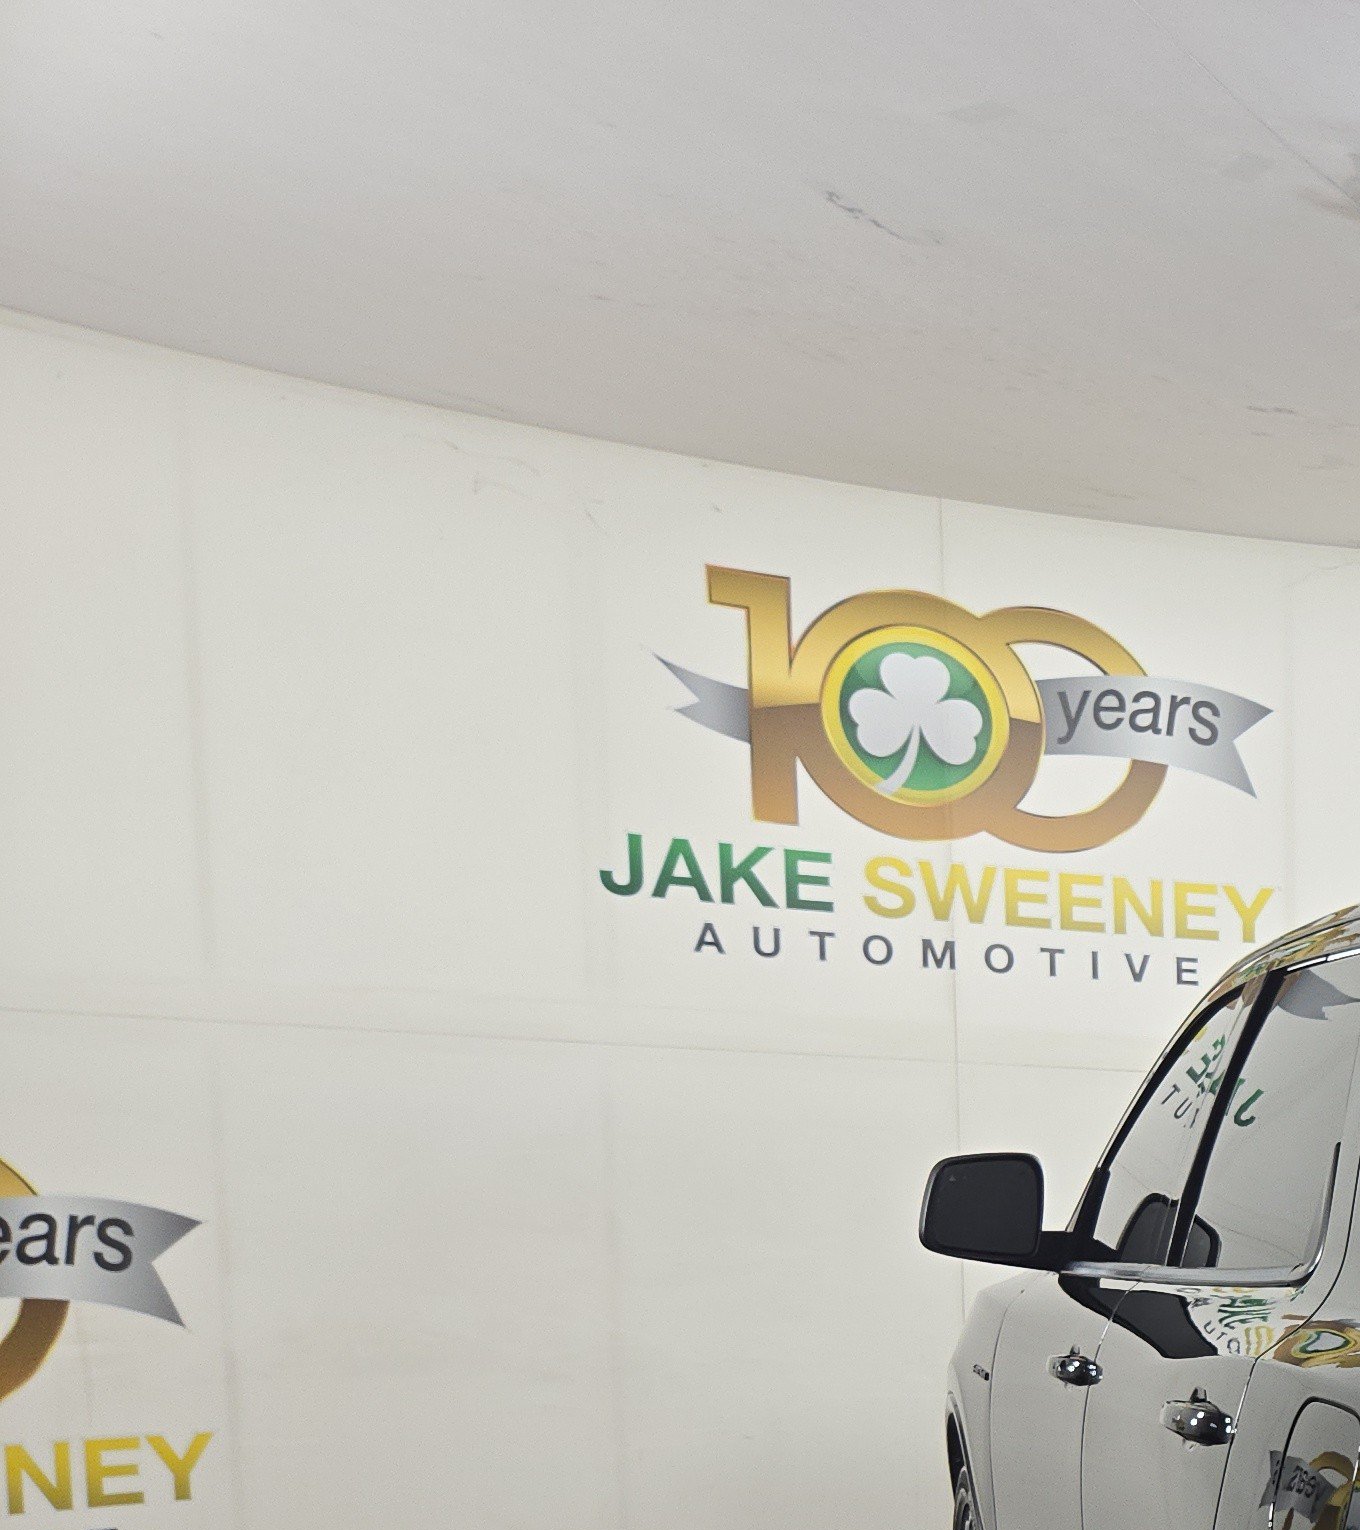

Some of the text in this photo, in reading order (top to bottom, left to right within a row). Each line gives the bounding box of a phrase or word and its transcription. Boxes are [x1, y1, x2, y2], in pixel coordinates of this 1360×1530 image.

[705, 564, 1222, 854] 100 years
[599, 832, 1274, 944] JAKE SWEENEY
[694, 922, 1200, 987] AUTOMOTIVE
